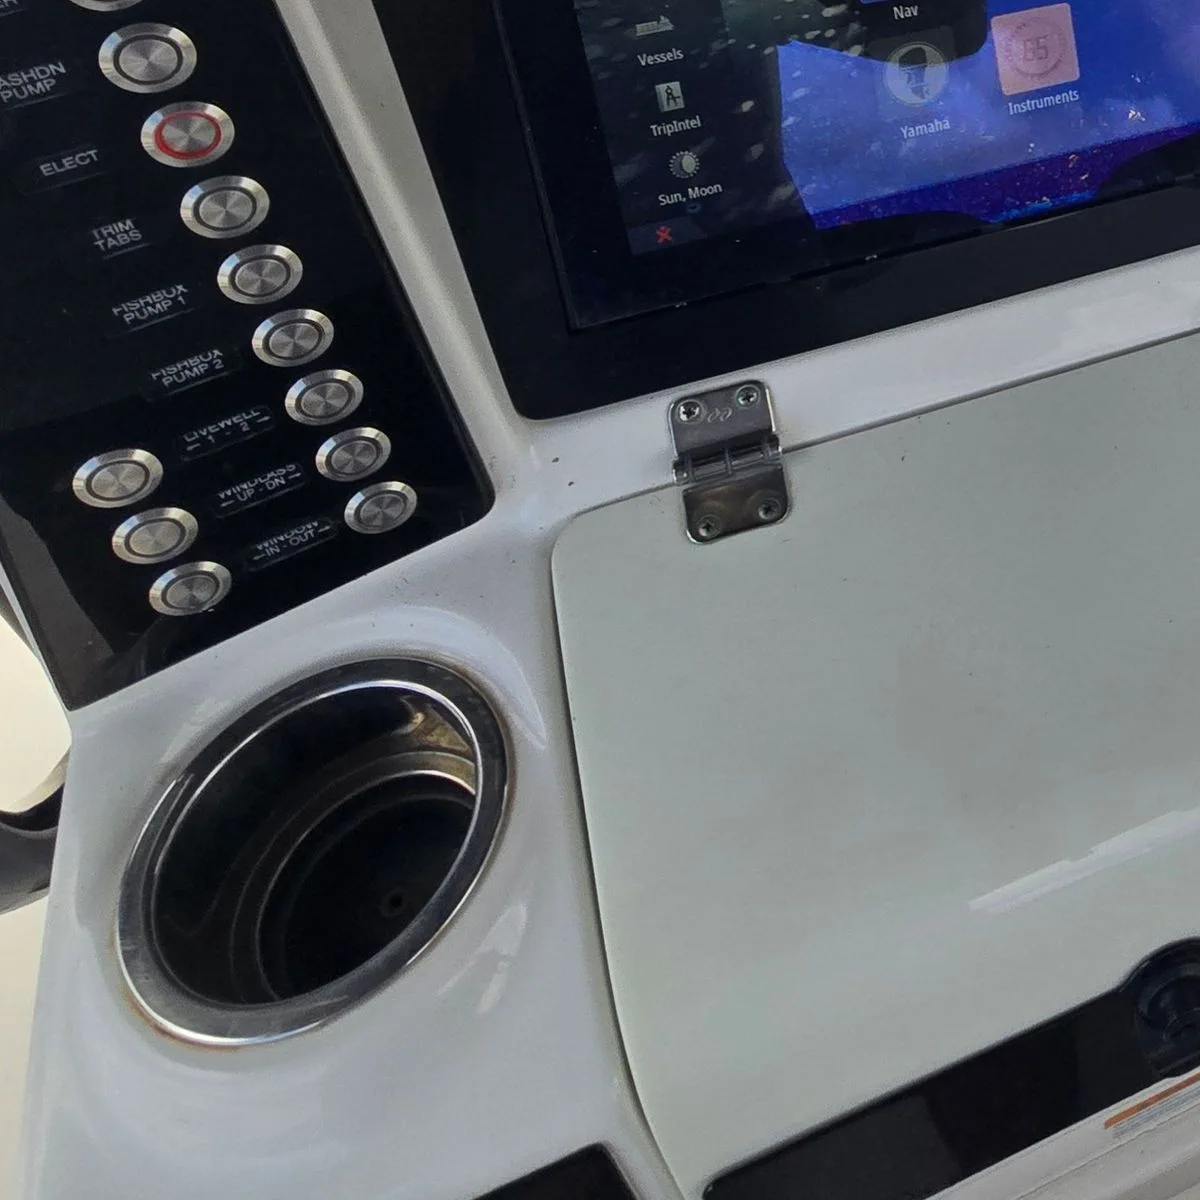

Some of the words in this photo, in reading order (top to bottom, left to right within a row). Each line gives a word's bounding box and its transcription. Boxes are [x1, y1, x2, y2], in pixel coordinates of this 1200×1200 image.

[893, 4, 919, 20] Nav
[637, 47, 684, 67] Vessels
[0, 78, 56, 104] PUMP
[1007, 88, 1080, 116] Instruments
[650, 115, 701, 138] TripIntel
[899, 117, 951, 140] Yamaha
[39, 149, 101, 178] ELECT
[658, 188, 687, 207] Sun,
[688, 182, 723, 201] Moon
[93, 218, 135, 240] TRIM
[94, 229, 142, 253] TABS
[112, 284, 189, 317] FISHBOX
[123, 299, 175, 325] PUMP
[178, 295, 187, 306] 1
[150, 348, 224, 382] FISHBOX
[161, 363, 212, 388] PUMP
[213, 358, 225, 370] 2
[182, 408, 262, 443] LIVEWELL
[239, 420, 251, 432] 2
[236, 486, 257, 503] UP
[265, 475, 287, 493] DN
[265, 543, 281, 557] IN
[289, 529, 317, 548] OUT
